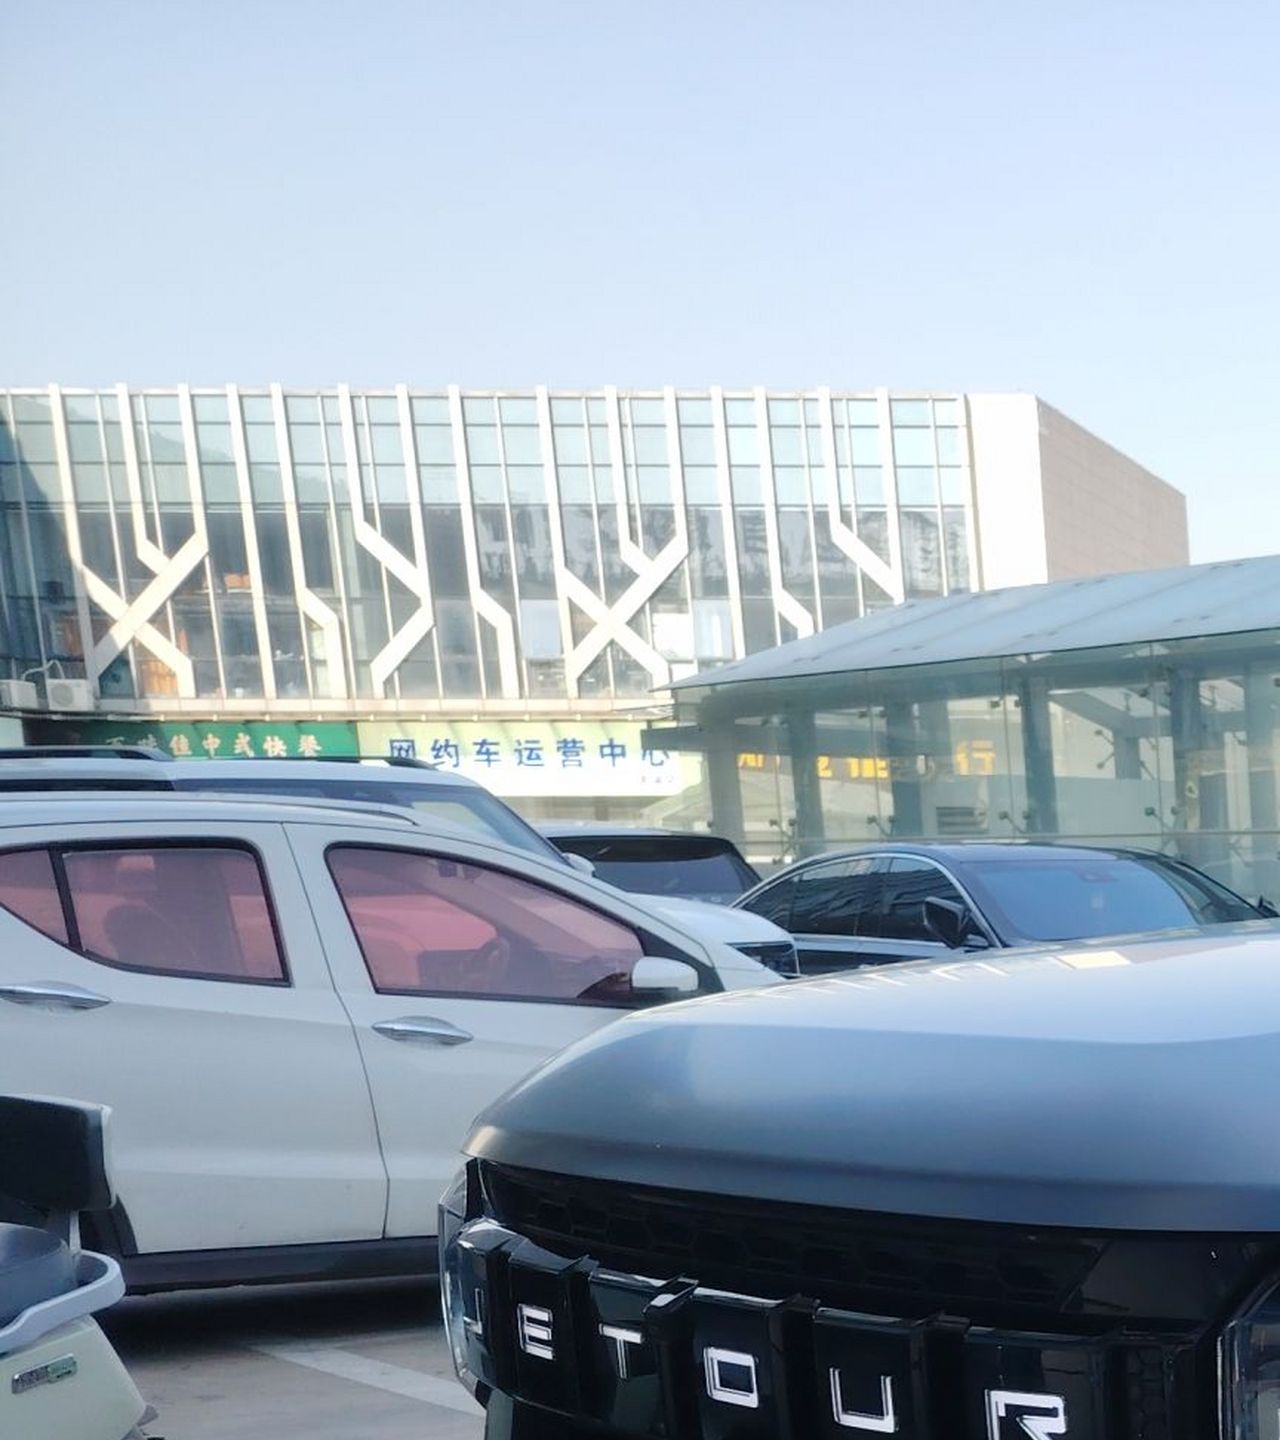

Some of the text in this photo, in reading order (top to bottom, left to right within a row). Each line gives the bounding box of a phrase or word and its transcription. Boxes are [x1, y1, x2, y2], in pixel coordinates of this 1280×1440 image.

[389, 738, 671, 768] 网约车运营中心
